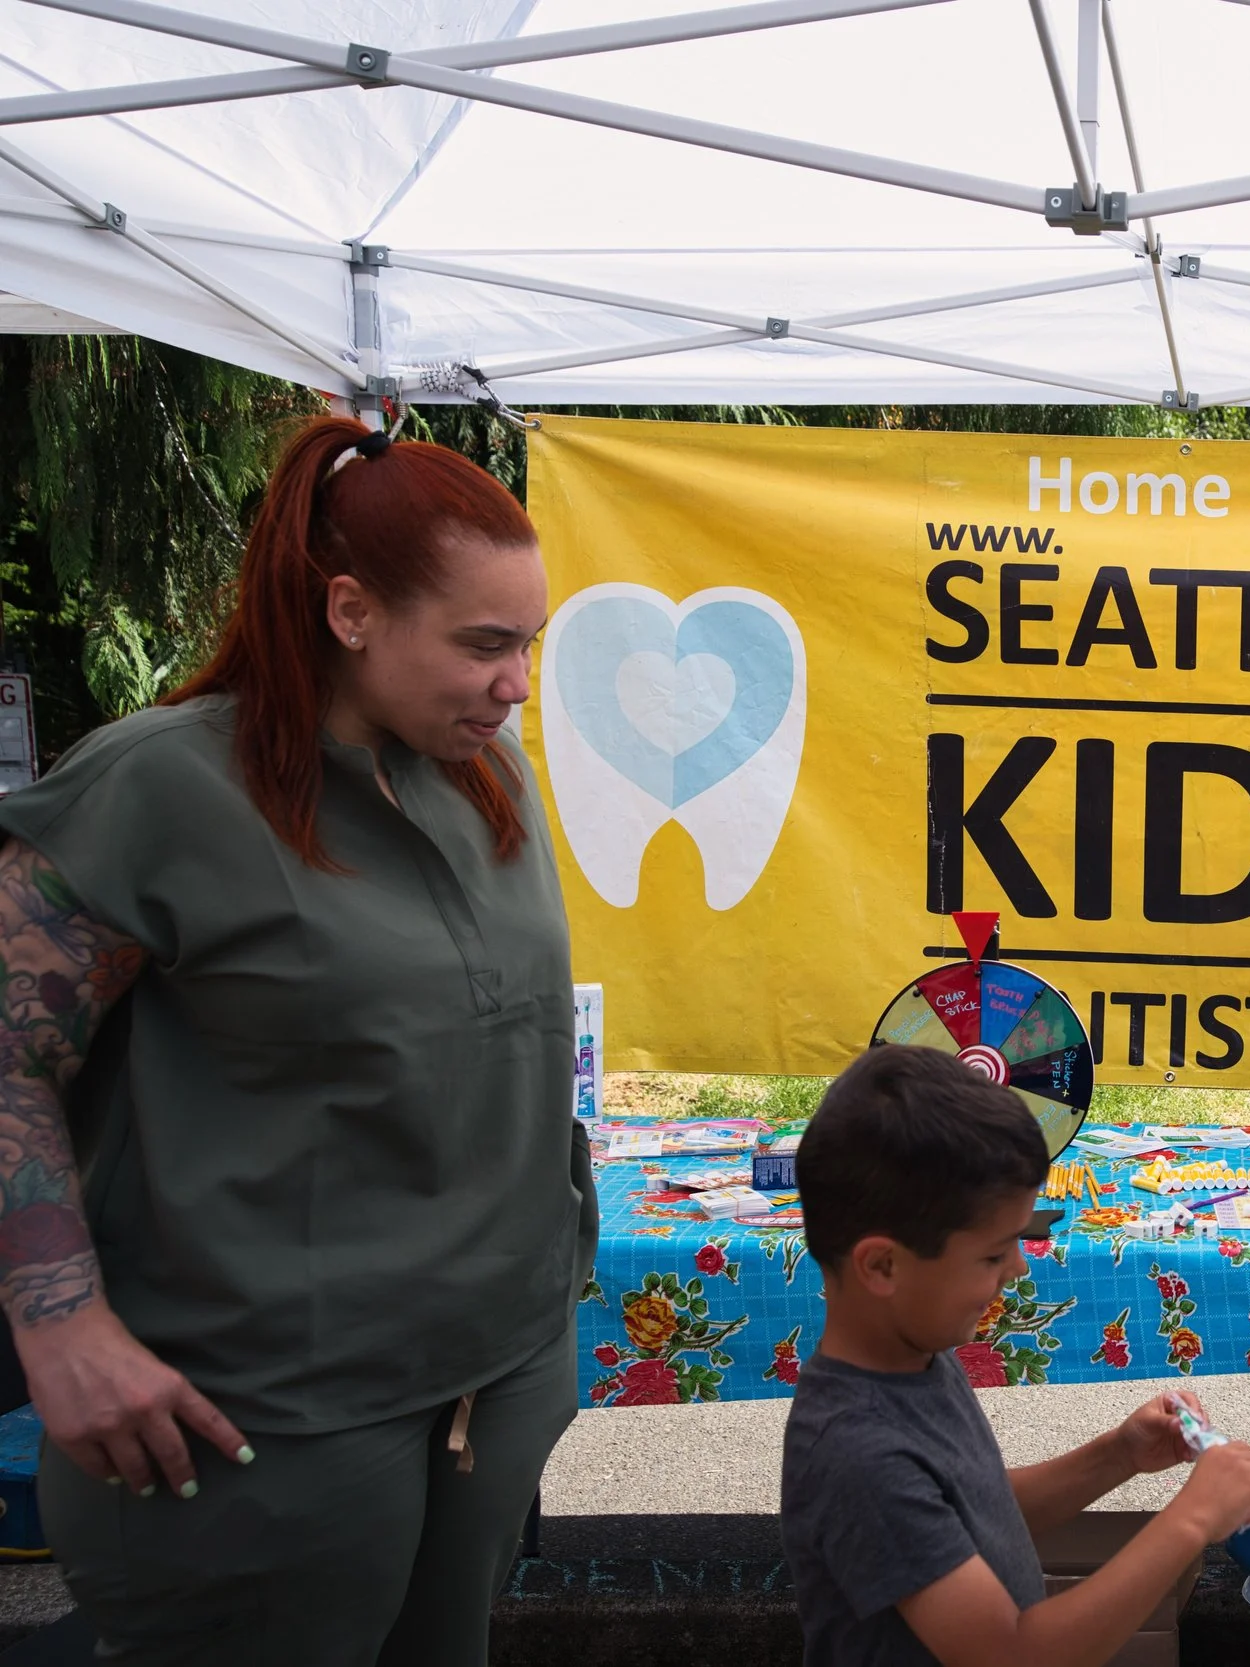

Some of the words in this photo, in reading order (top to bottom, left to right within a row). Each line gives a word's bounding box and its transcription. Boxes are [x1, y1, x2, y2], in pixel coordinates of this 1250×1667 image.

[1028, 455, 1232, 520] Home
[925, 521, 1064, 555] www.
[936, 990, 966, 1007] CHAP
[1051, 1060, 1061, 1089] PEN
[1063, 1050, 1078, 1089] Sticker
